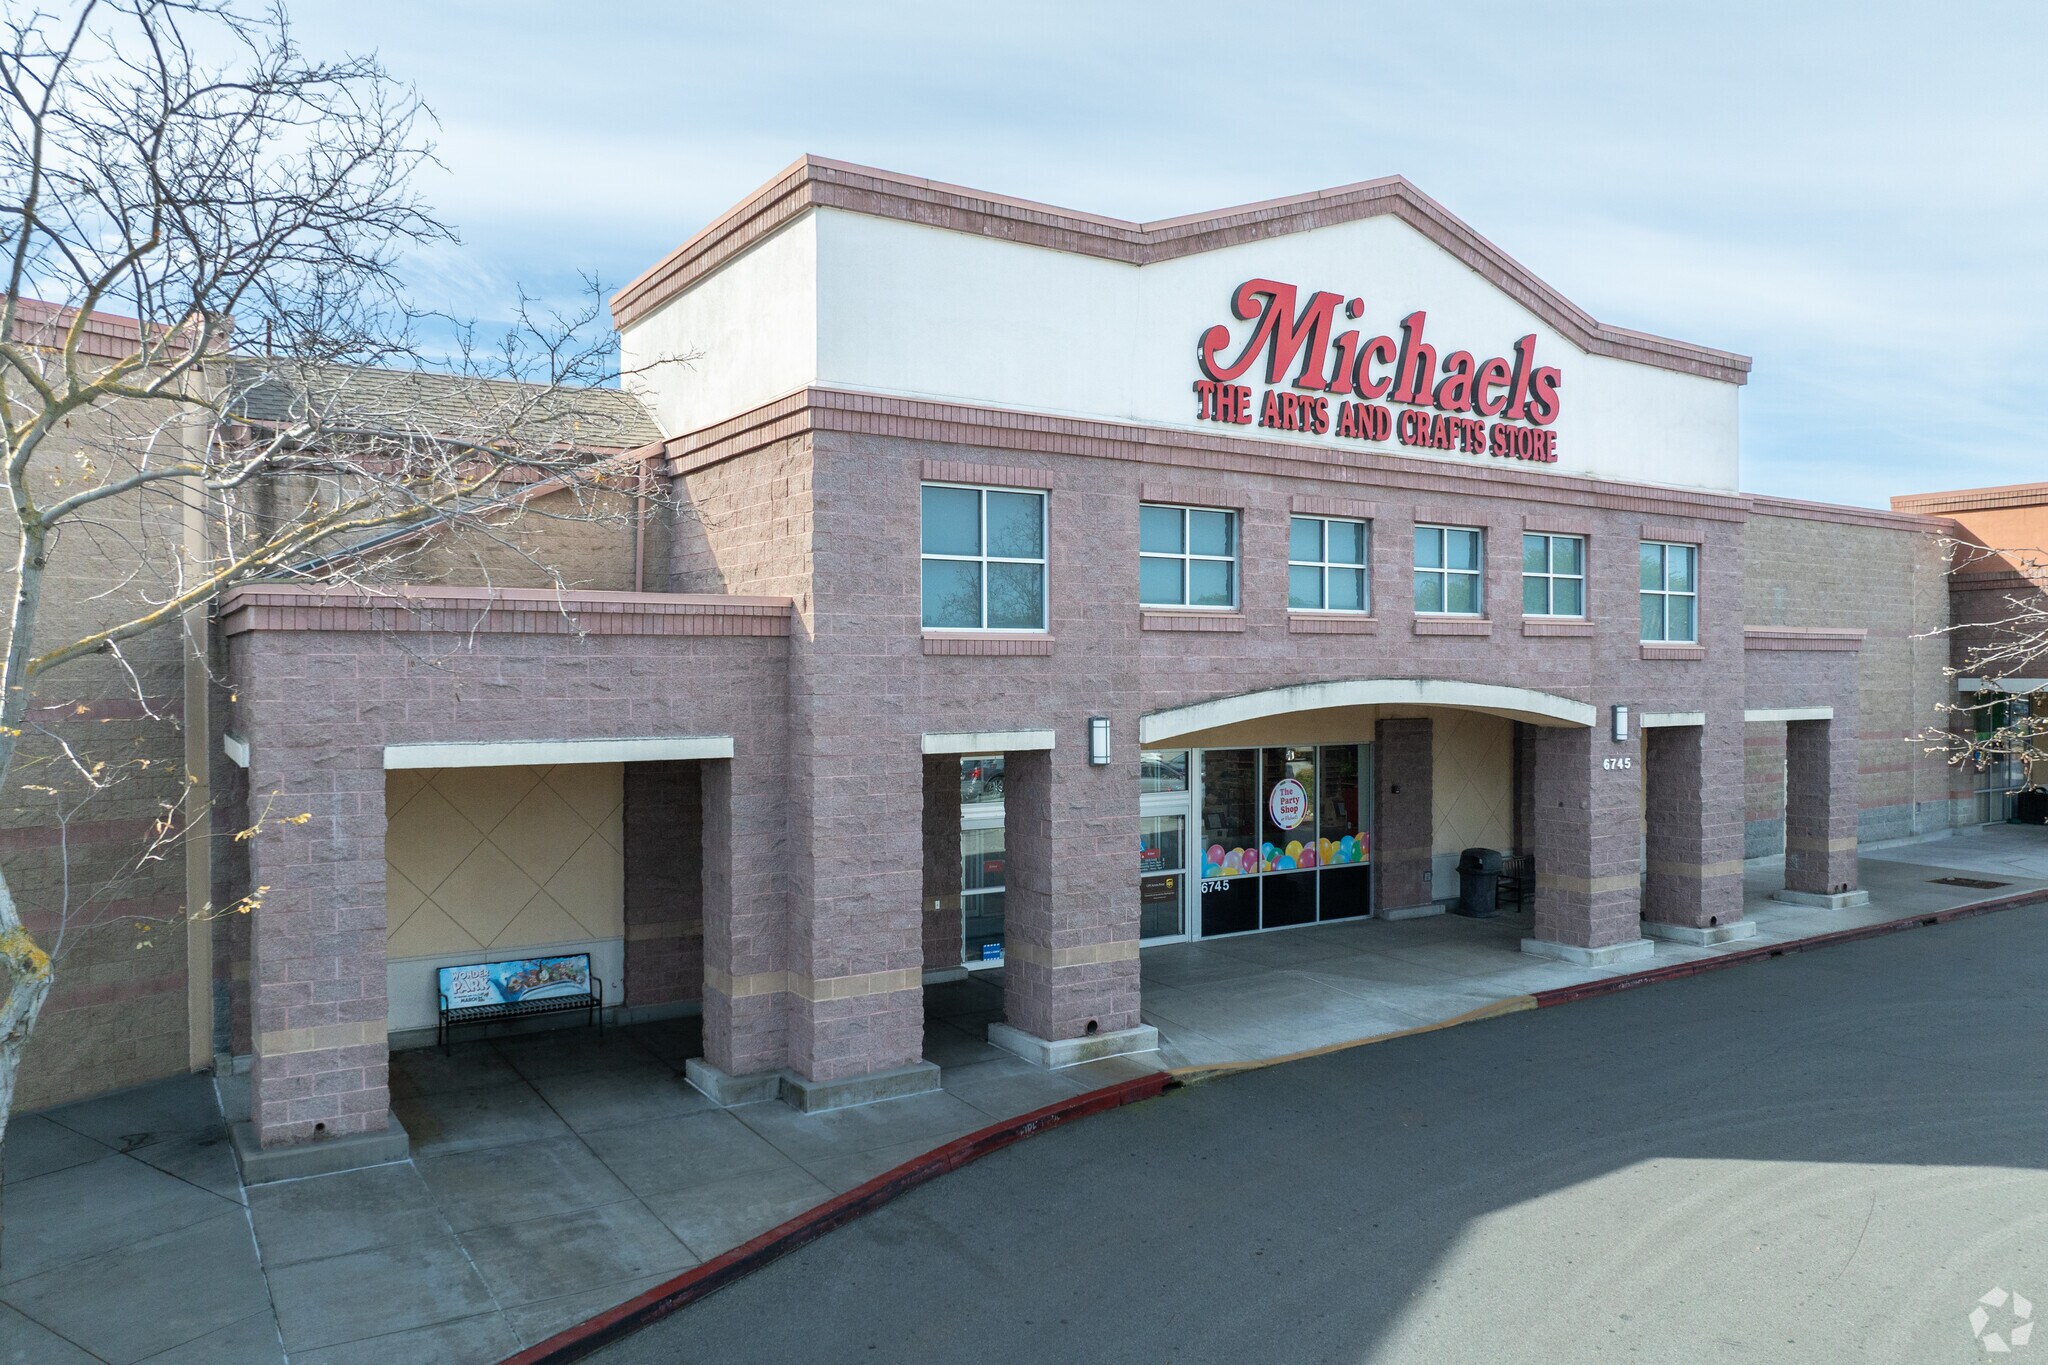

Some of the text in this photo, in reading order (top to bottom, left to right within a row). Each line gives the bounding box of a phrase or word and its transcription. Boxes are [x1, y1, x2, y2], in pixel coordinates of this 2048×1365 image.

[1198, 278, 1561, 426] Michaels
[1193, 380, 1558, 463] THE ARTS AND CRAFTS STORE
[1603, 758, 1631, 770] 6745
[1280, 788, 1293, 796] The
[1280, 797, 1300, 805] Party
[1280, 806, 1299, 814] Shop
[1201, 879, 1229, 894] 6745
[453, 970, 489, 981] WONDER
[453, 979, 490, 994] PARK
